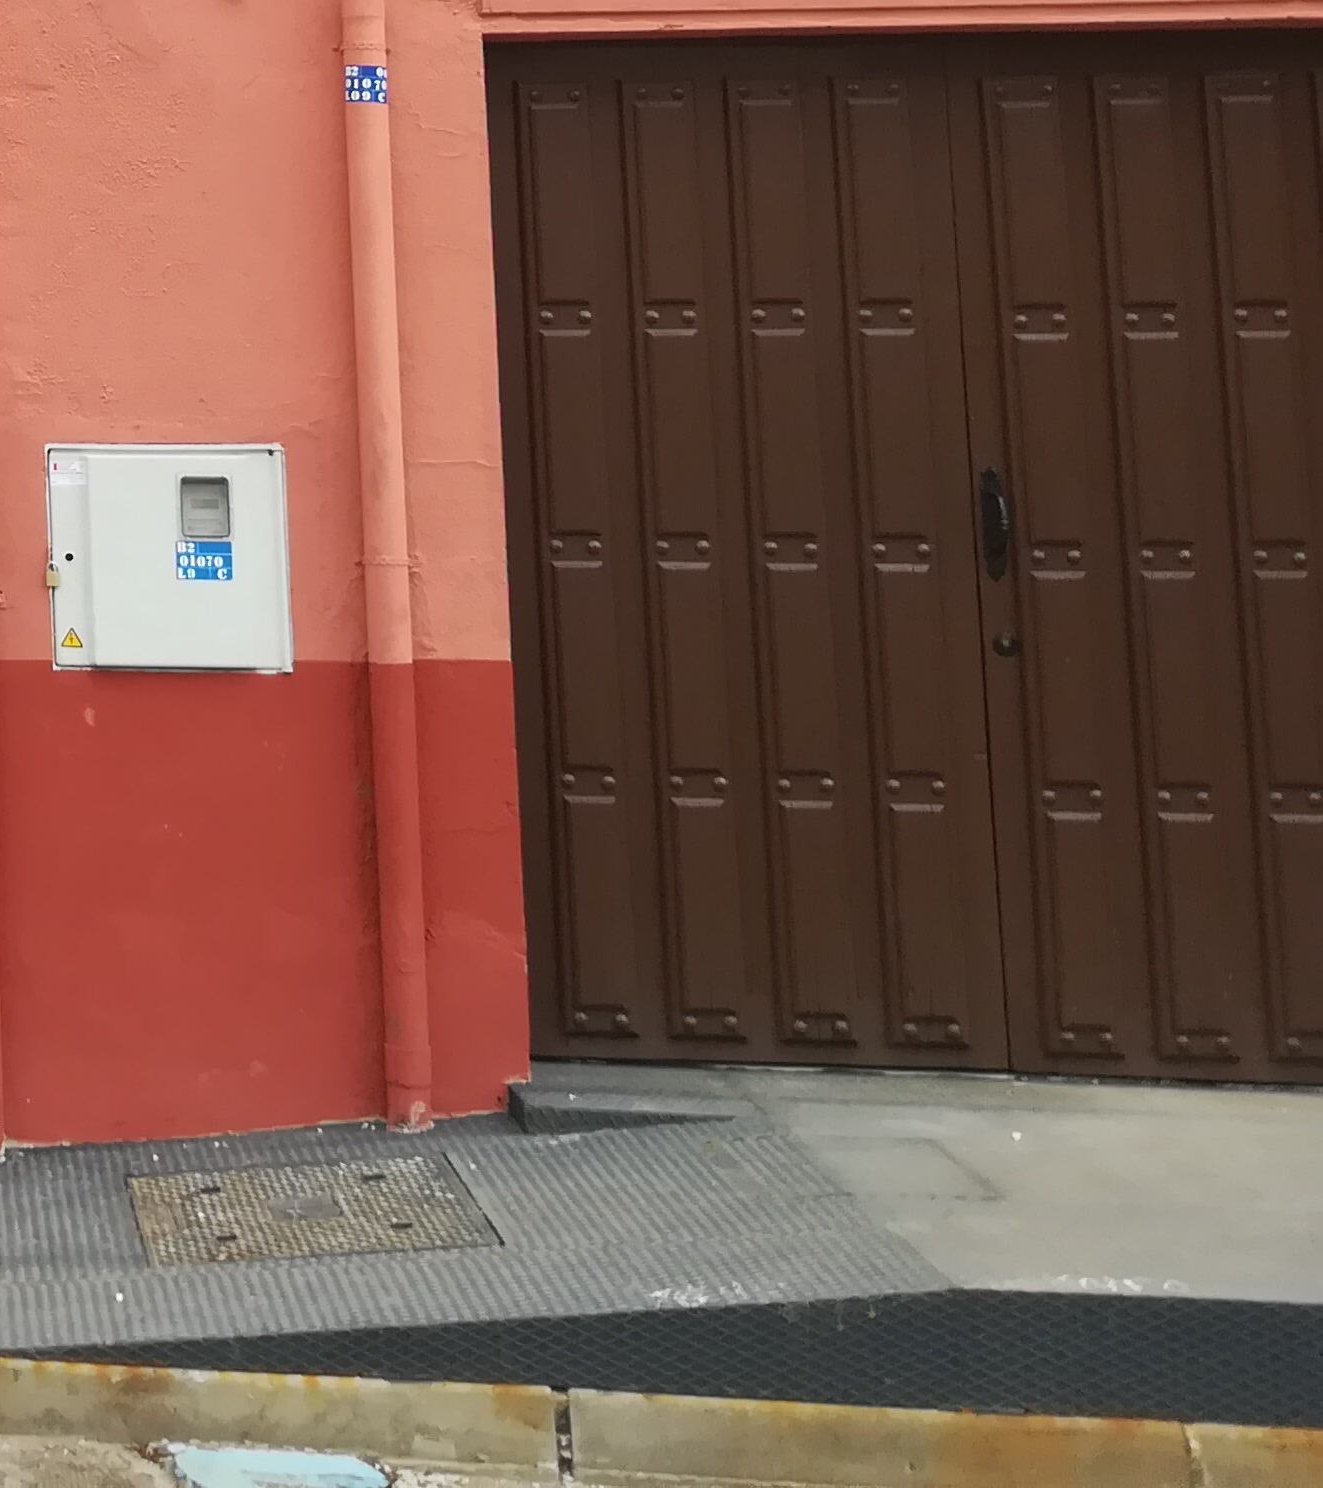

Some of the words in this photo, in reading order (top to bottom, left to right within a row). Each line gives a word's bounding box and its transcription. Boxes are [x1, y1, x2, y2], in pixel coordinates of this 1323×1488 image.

[177, 541, 196, 553] B2
[179, 554, 224, 568] 01070
[217, 568, 228, 580] C
